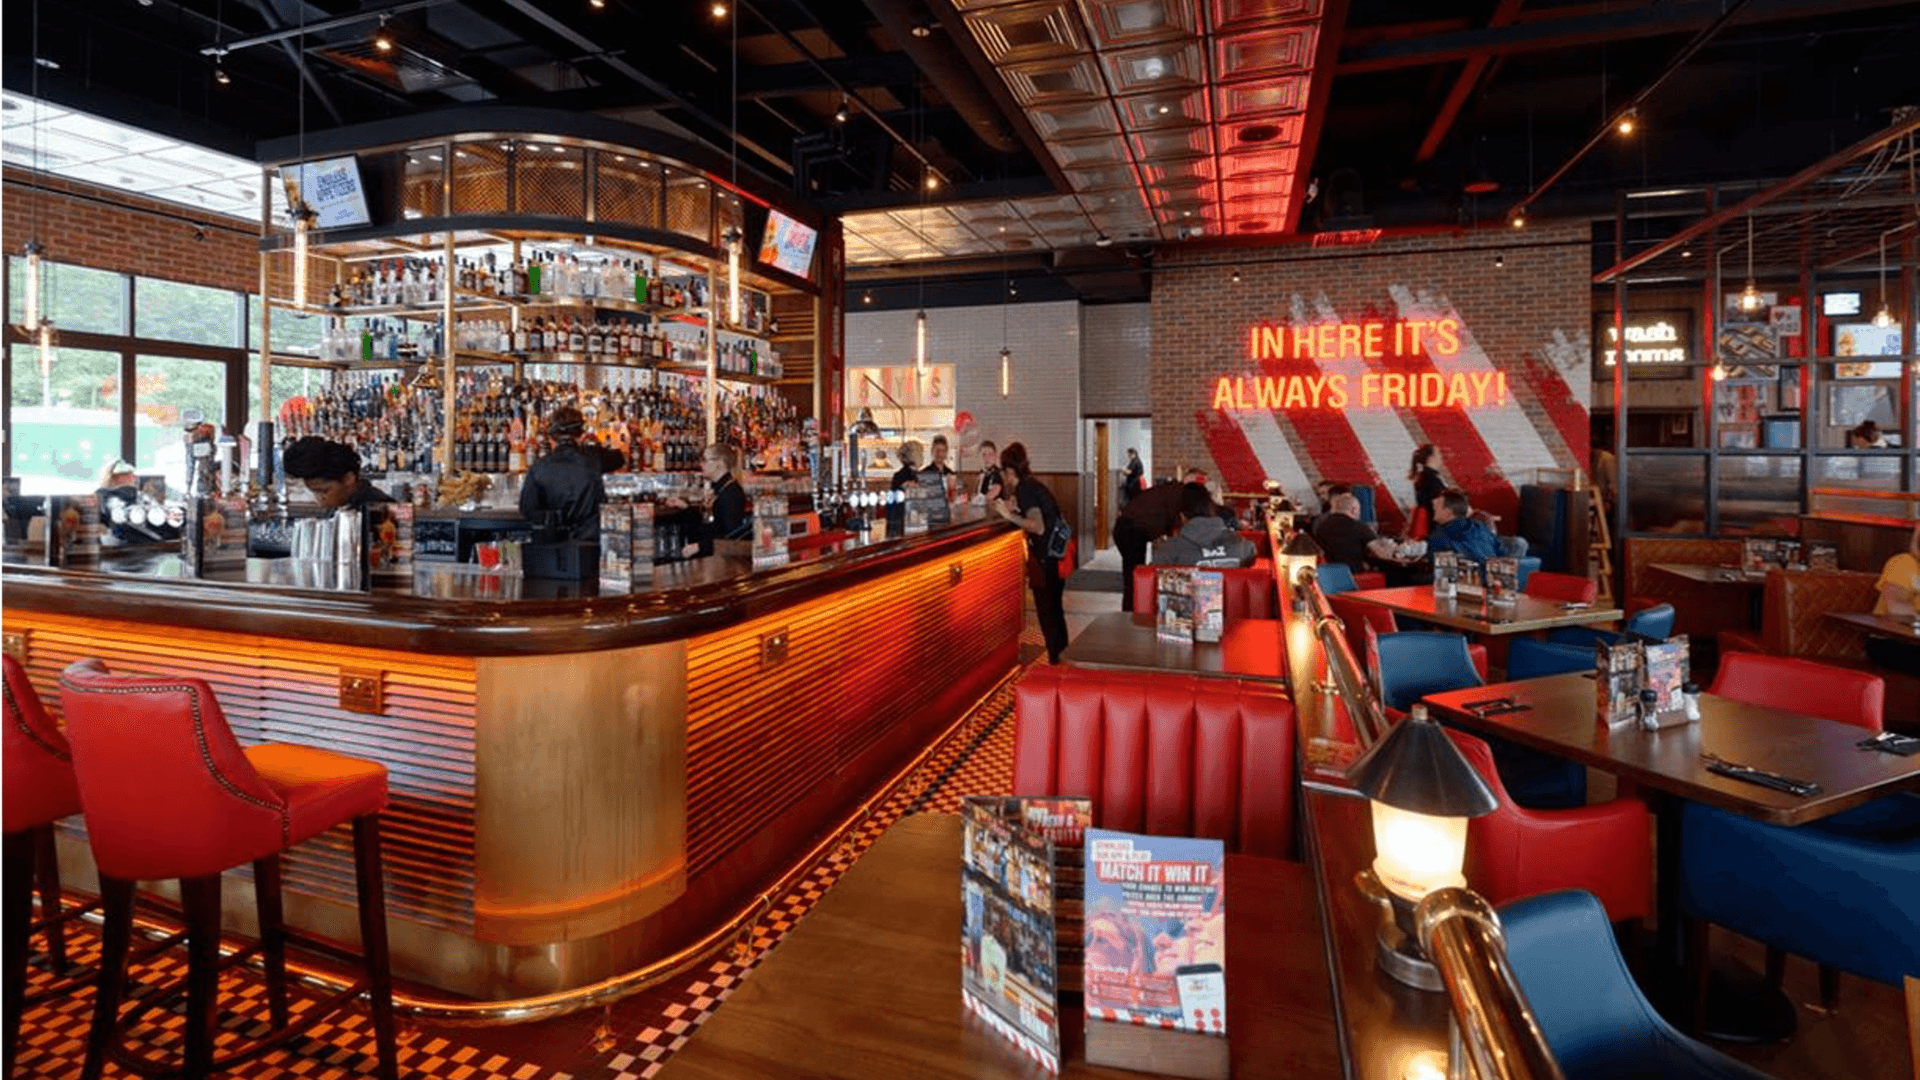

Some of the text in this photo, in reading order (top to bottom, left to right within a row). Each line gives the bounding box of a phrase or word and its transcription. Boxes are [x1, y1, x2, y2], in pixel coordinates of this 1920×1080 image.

[1251, 319, 1459, 359] IN HERE IT'S
[1212, 371, 1506, 409] ALWAYS FRIDAY!
[1100, 861, 1207, 883] MATCH IT WIN IT
